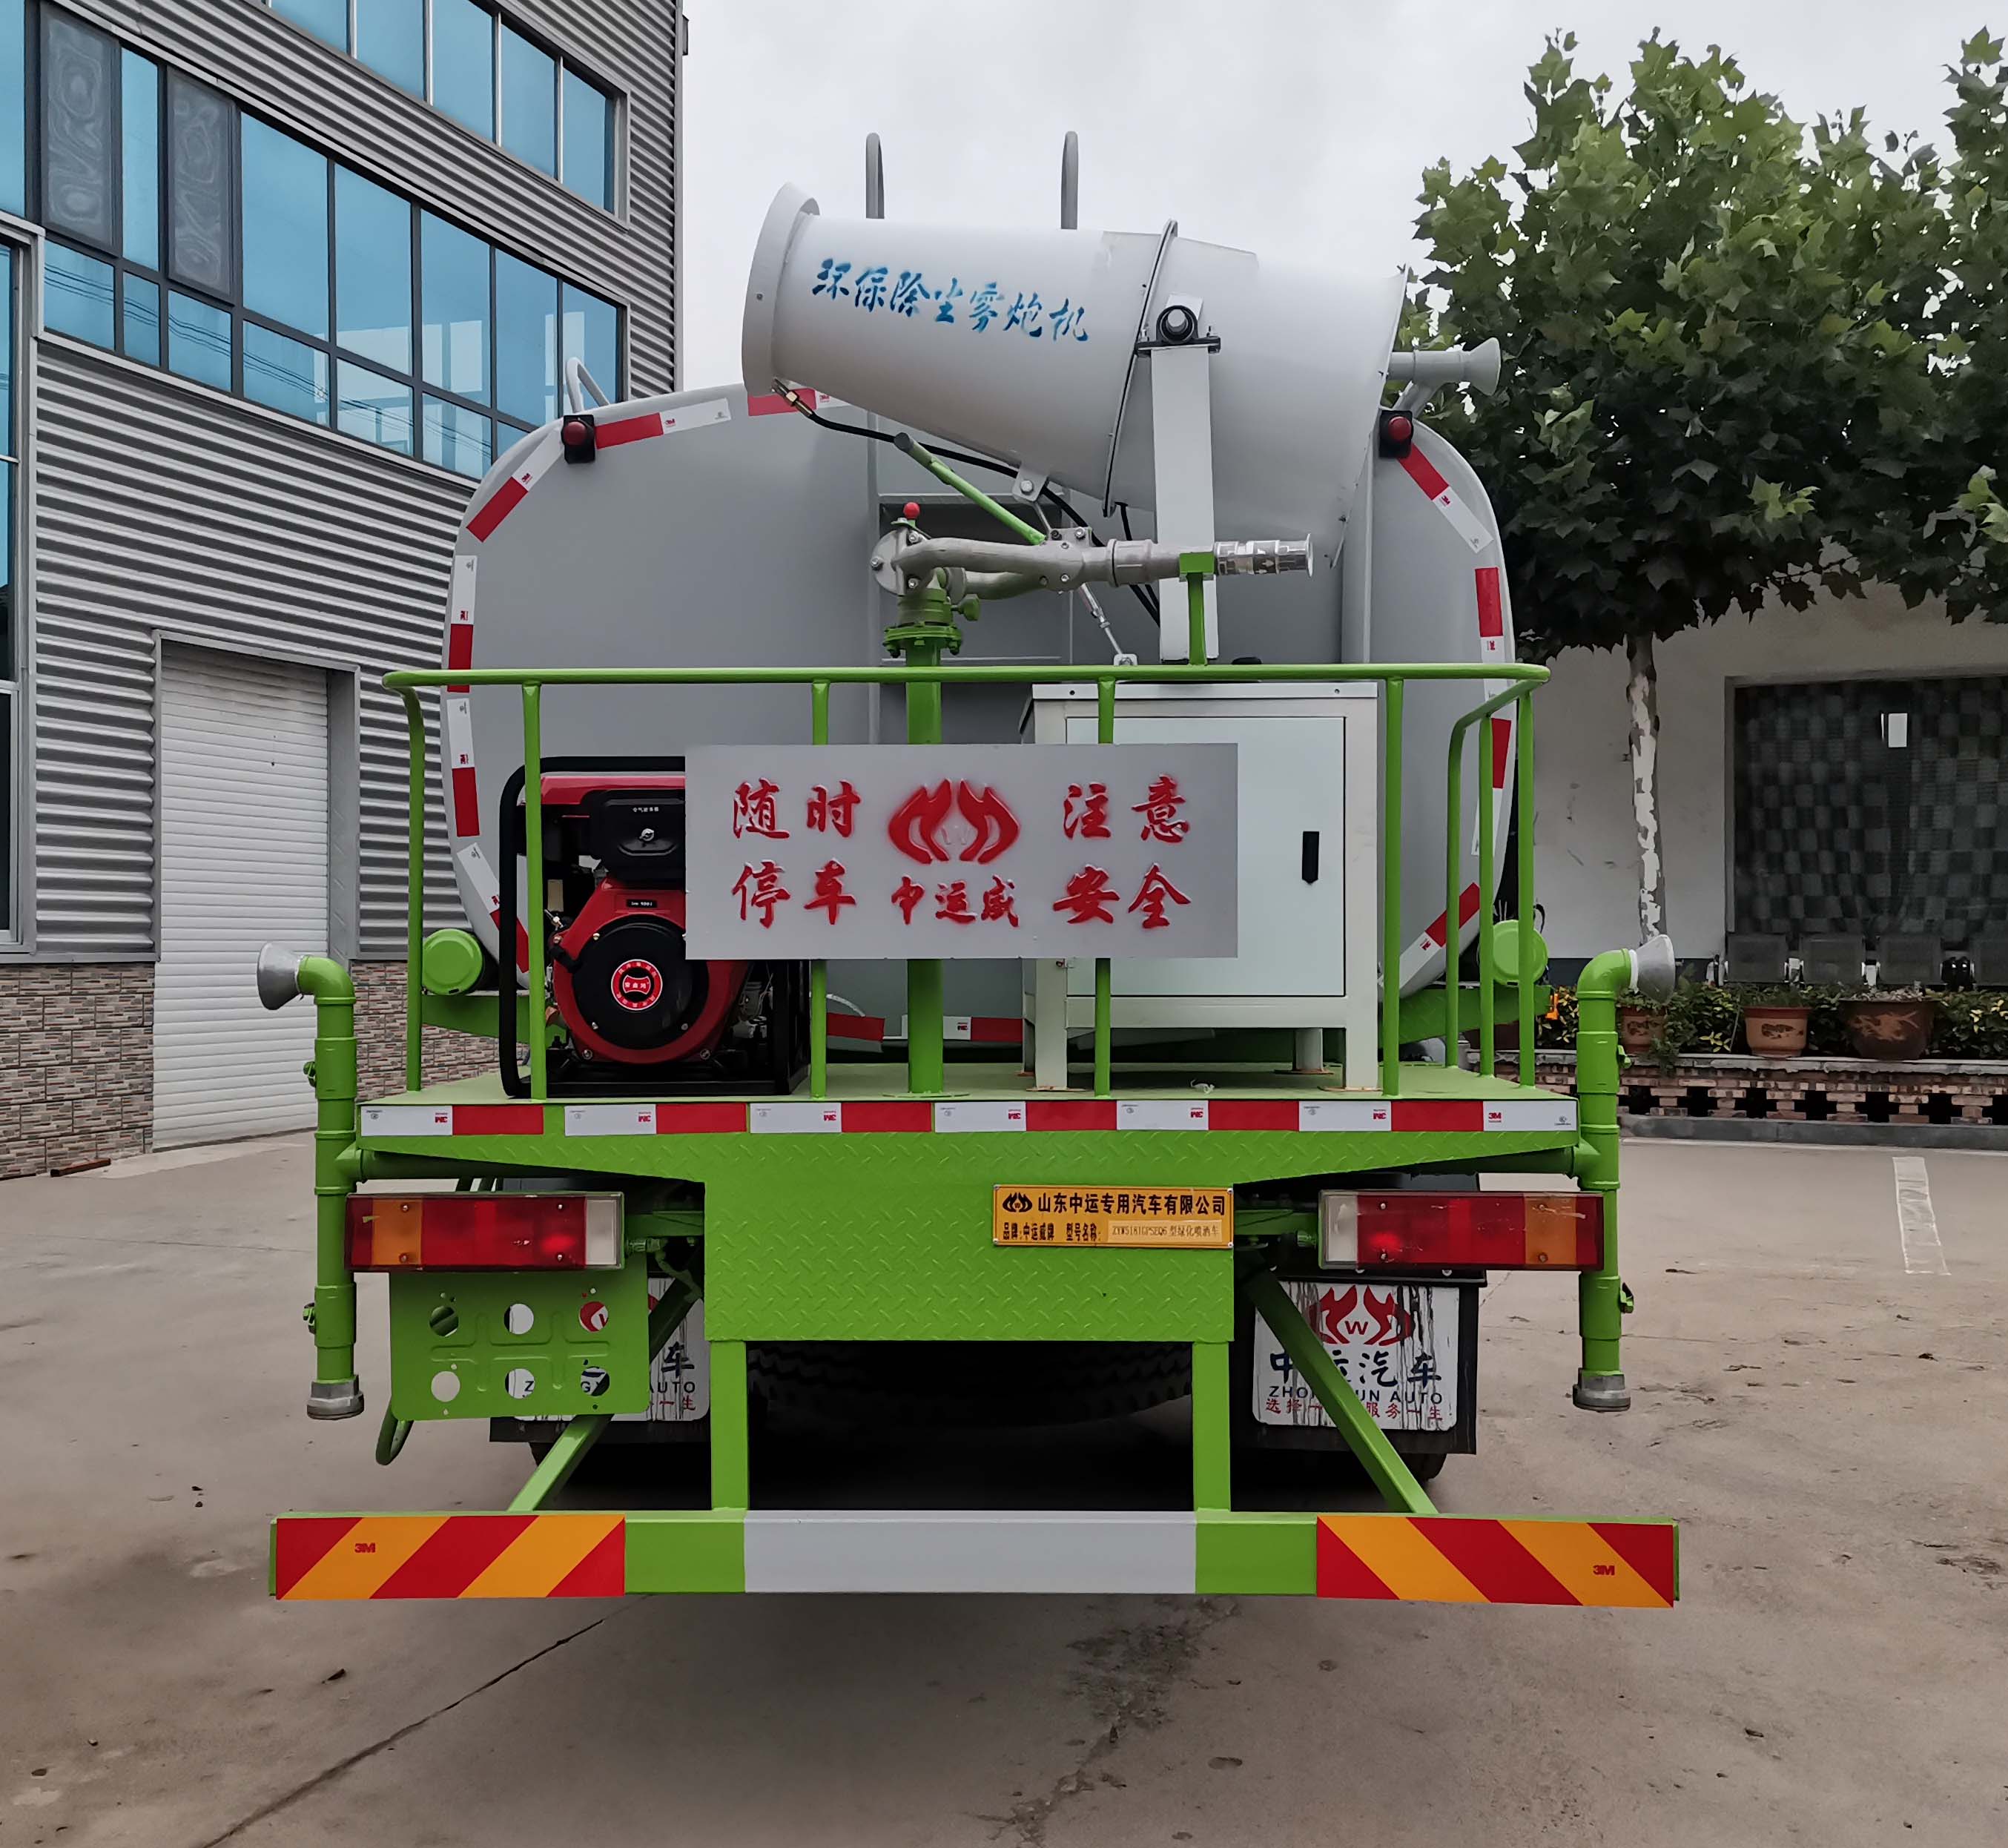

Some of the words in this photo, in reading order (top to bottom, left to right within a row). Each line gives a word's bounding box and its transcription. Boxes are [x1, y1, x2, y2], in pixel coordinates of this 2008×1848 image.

[812, 257, 1088, 342] 环保除尘雾炮机
[733, 777, 860, 839] 随时
[1063, 773, 1190, 843] 注意
[731, 859, 857, 928] 停车
[891, 874, 1020, 928] 中运威
[1052, 863, 1192, 929] 安全
[1037, 1192, 1225, 1216] 山东中运专用汽车有限公司
[650, 1382, 696, 1393] UTO
[1390, 1390, 1442, 1405] AUTO
[354, 1542, 376, 1554] 3M
[1593, 1565, 1615, 1576] 3M
